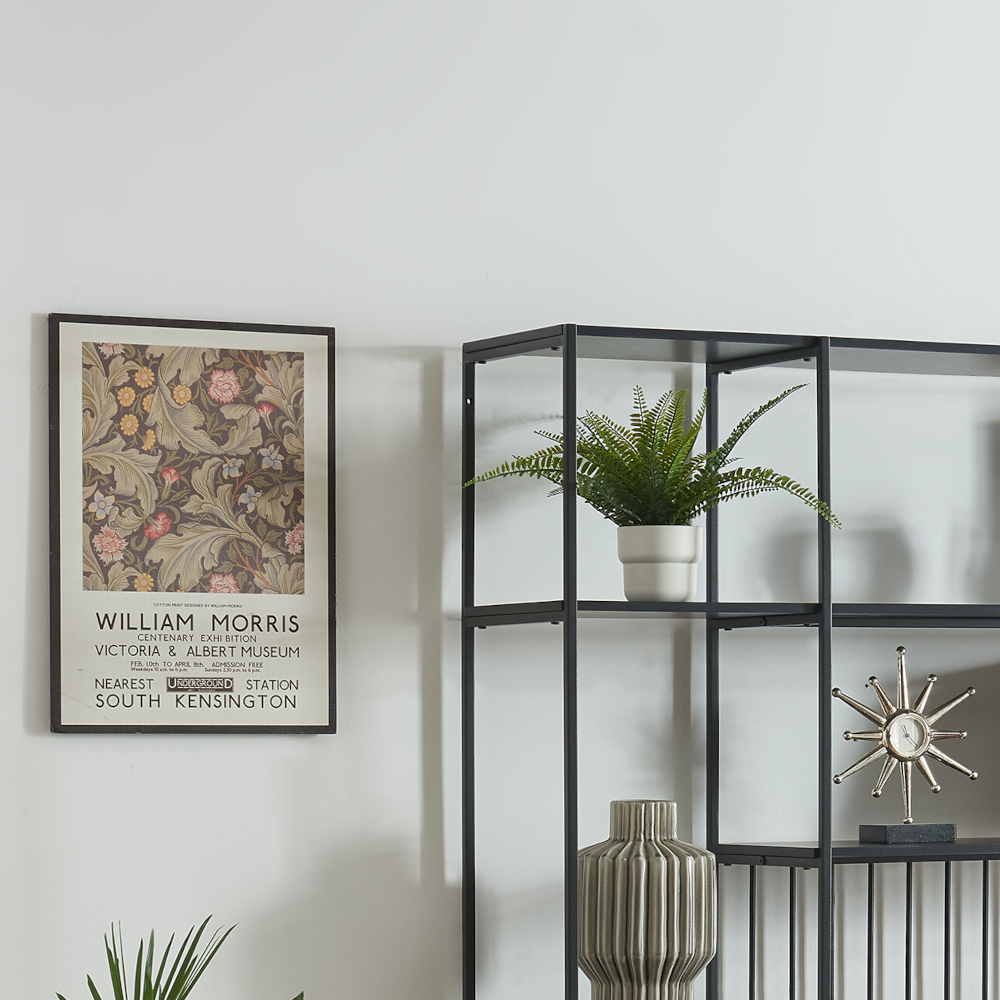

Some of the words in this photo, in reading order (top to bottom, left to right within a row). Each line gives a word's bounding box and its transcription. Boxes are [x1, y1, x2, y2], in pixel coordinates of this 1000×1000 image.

[95, 612, 194, 631] WILLIAM
[211, 614, 299, 633] MORRIS
[137, 633, 195, 642] CENTENARY
[95, 644, 161, 657] VICTORIA
[168, 645, 177, 657] &
[186, 645, 237, 658] ALBERT
[241, 646, 300, 658] MUSEUM
[94, 678, 154, 689] NEAREST
[168, 677, 233, 689] UNDERGROUND
[246, 679, 299, 690] STATION
[95, 693, 161, 708] SOUTH
[175, 694, 296, 708] KENSINGTON
